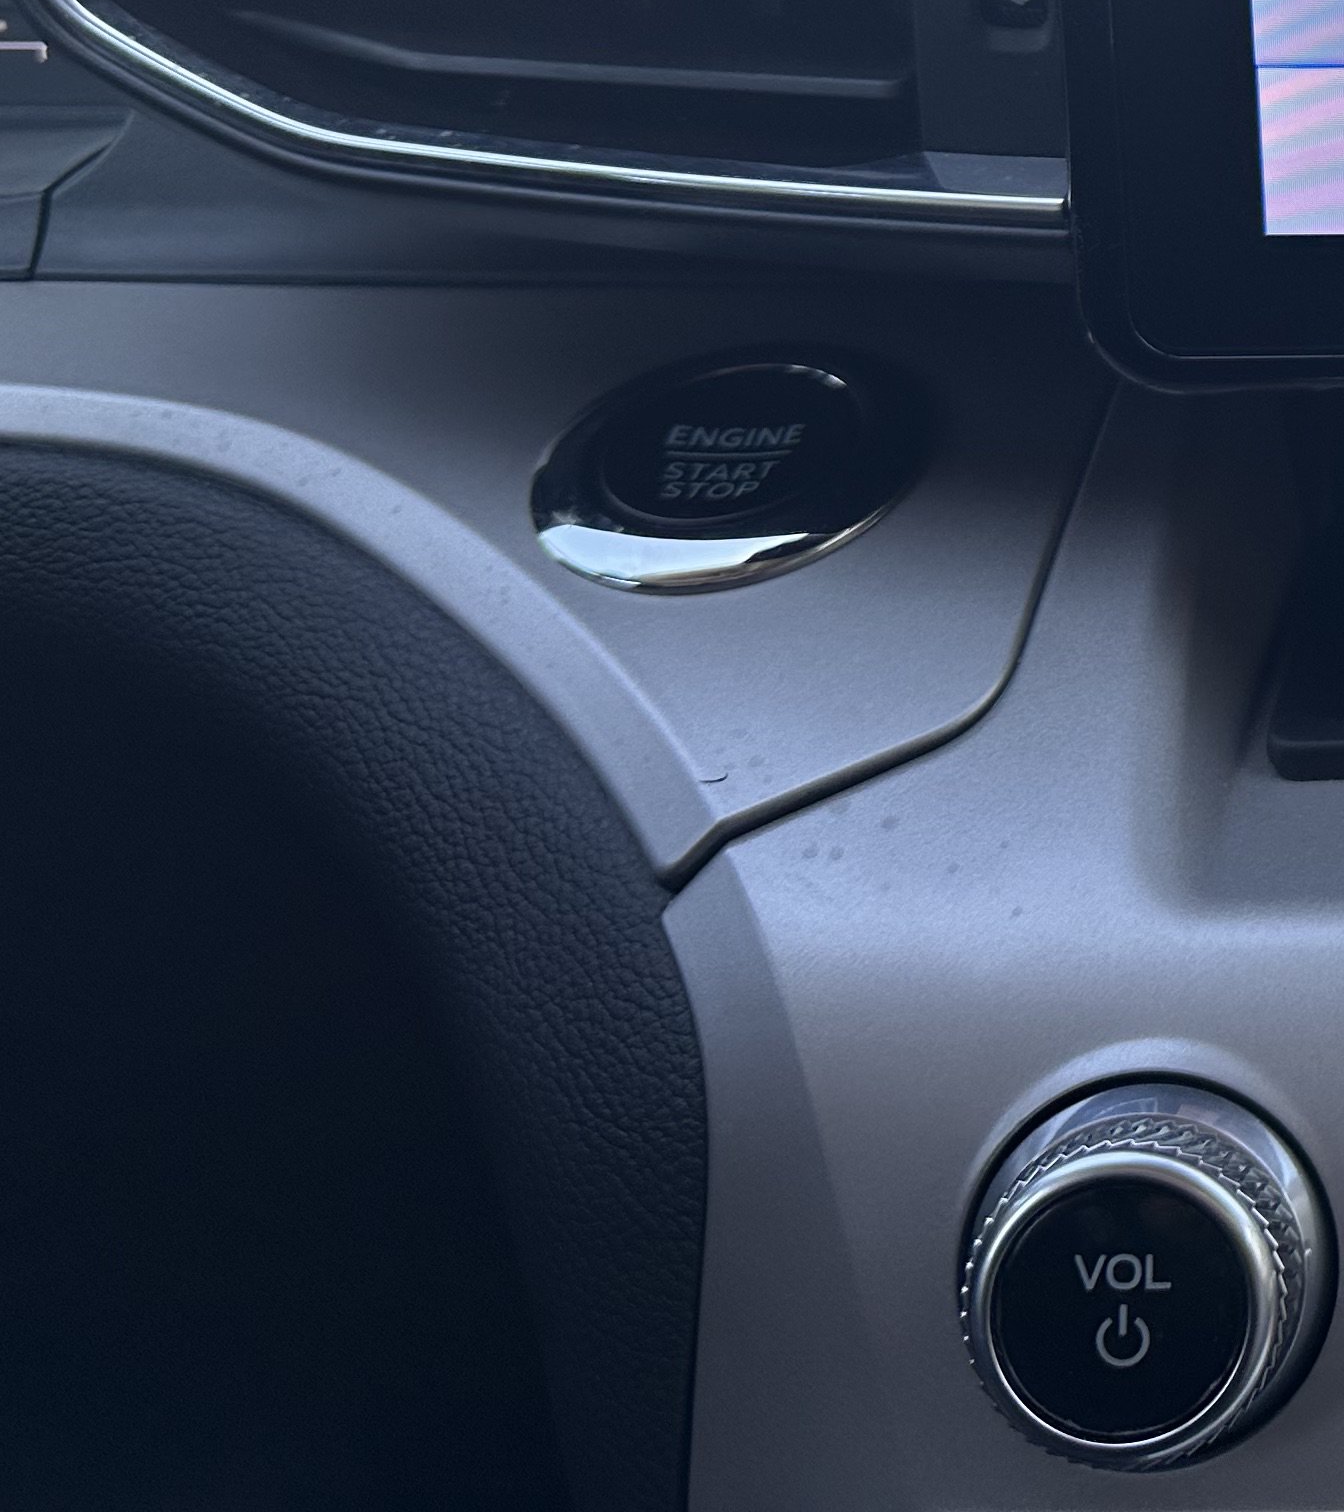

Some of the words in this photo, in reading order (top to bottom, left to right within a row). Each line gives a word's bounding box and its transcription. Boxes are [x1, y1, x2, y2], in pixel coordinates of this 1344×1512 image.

[667, 424, 806, 448] ENGINE
[664, 461, 779, 481] START
[661, 481, 760, 499] STOP
[1074, 1254, 1171, 1290] VOL
